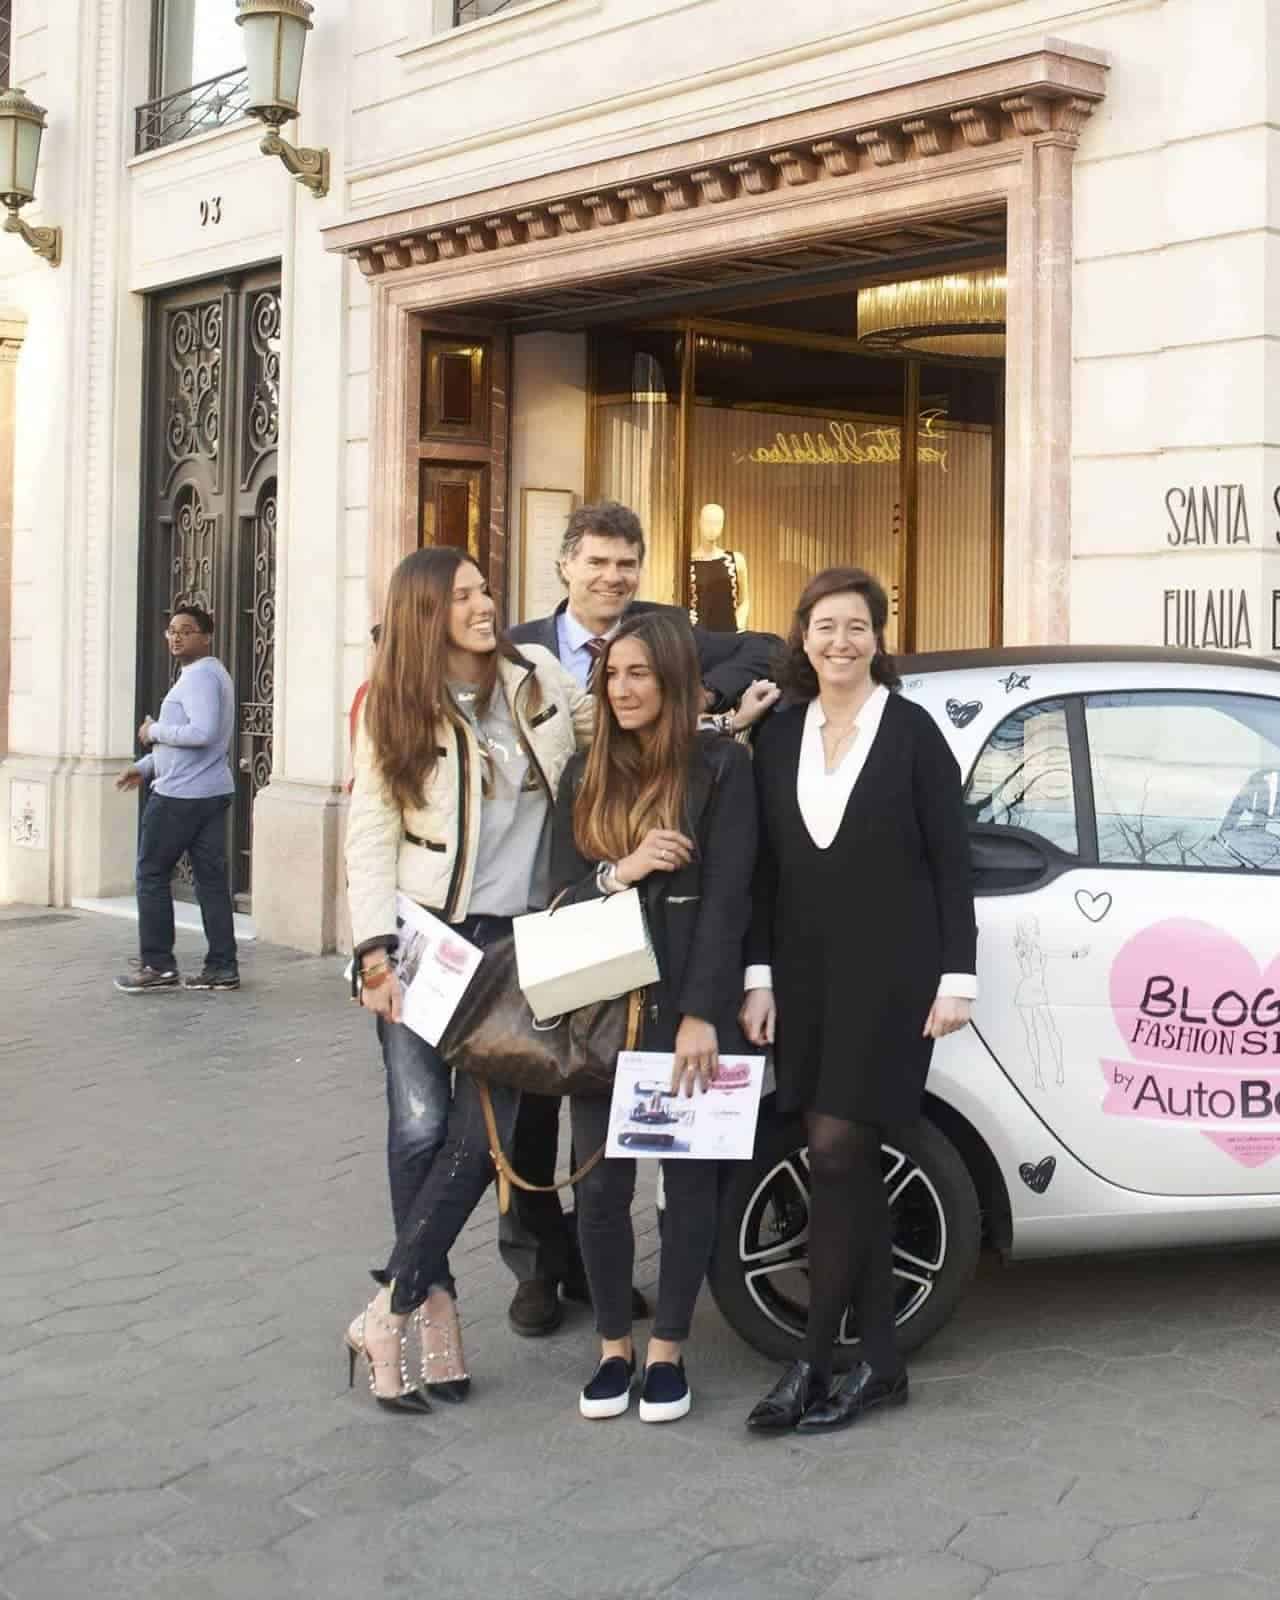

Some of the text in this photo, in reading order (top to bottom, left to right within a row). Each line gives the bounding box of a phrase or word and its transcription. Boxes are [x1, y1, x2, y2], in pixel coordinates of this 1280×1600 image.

[1165, 484, 1250, 546] SANTA
[1163, 588, 1252, 648] EULALIA
[1131, 1018, 1235, 1055] FASHION
[1113, 1067, 1135, 1093] by
